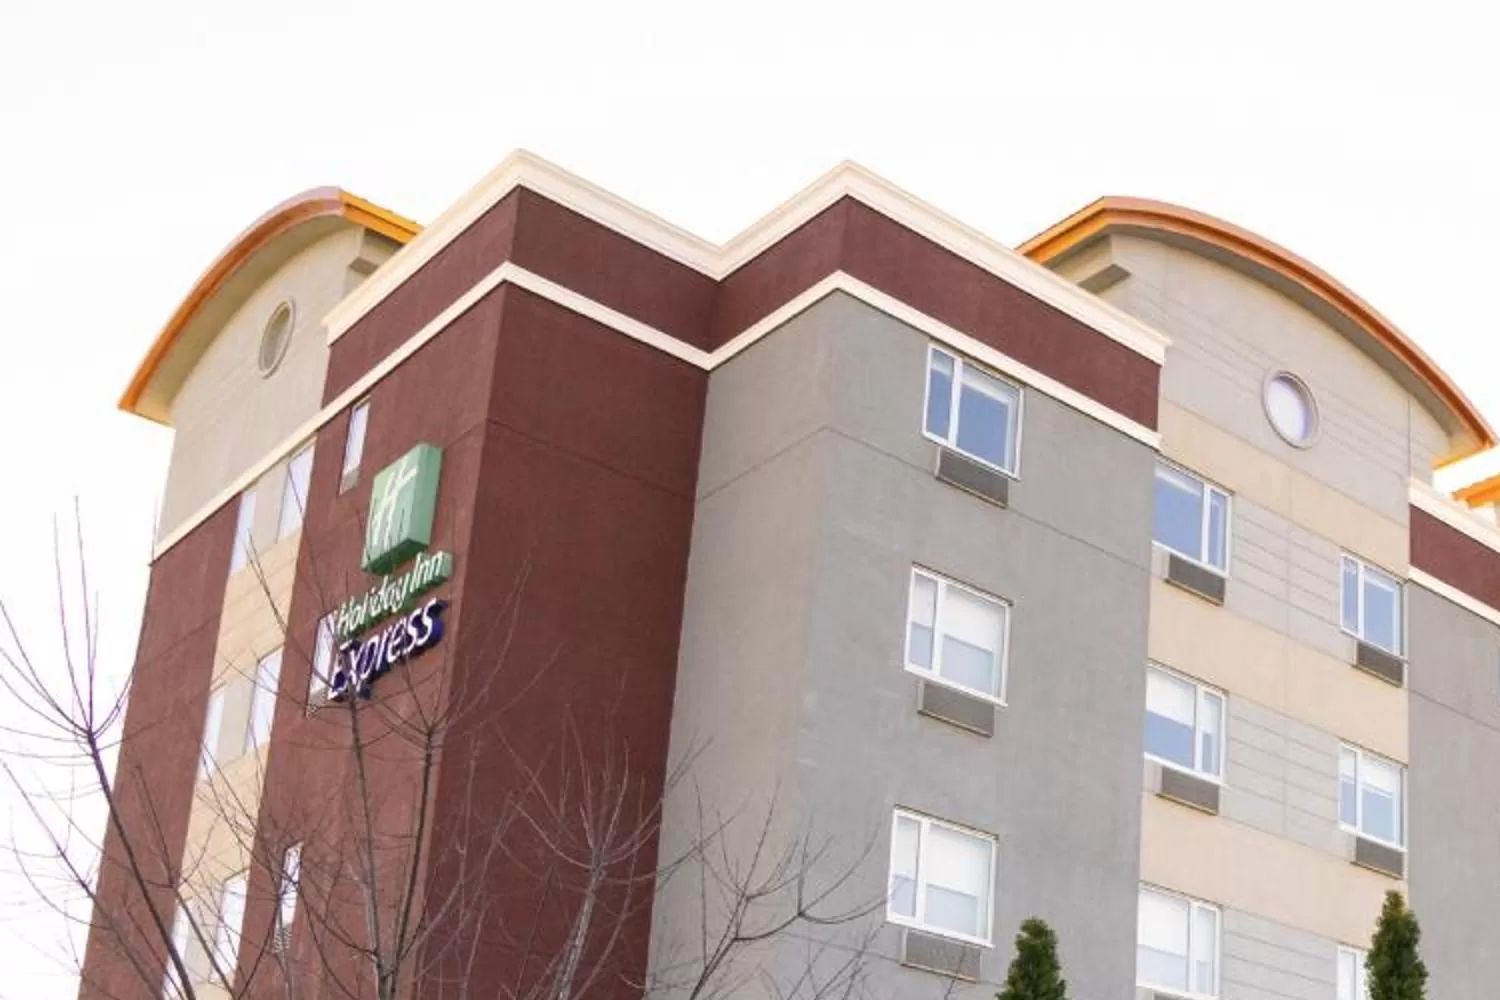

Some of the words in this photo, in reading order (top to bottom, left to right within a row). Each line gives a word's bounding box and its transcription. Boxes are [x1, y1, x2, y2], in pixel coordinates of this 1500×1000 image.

[337, 573, 410, 635] Holiday
[411, 550, 445, 593] Inn
[328, 598, 438, 699] Express
